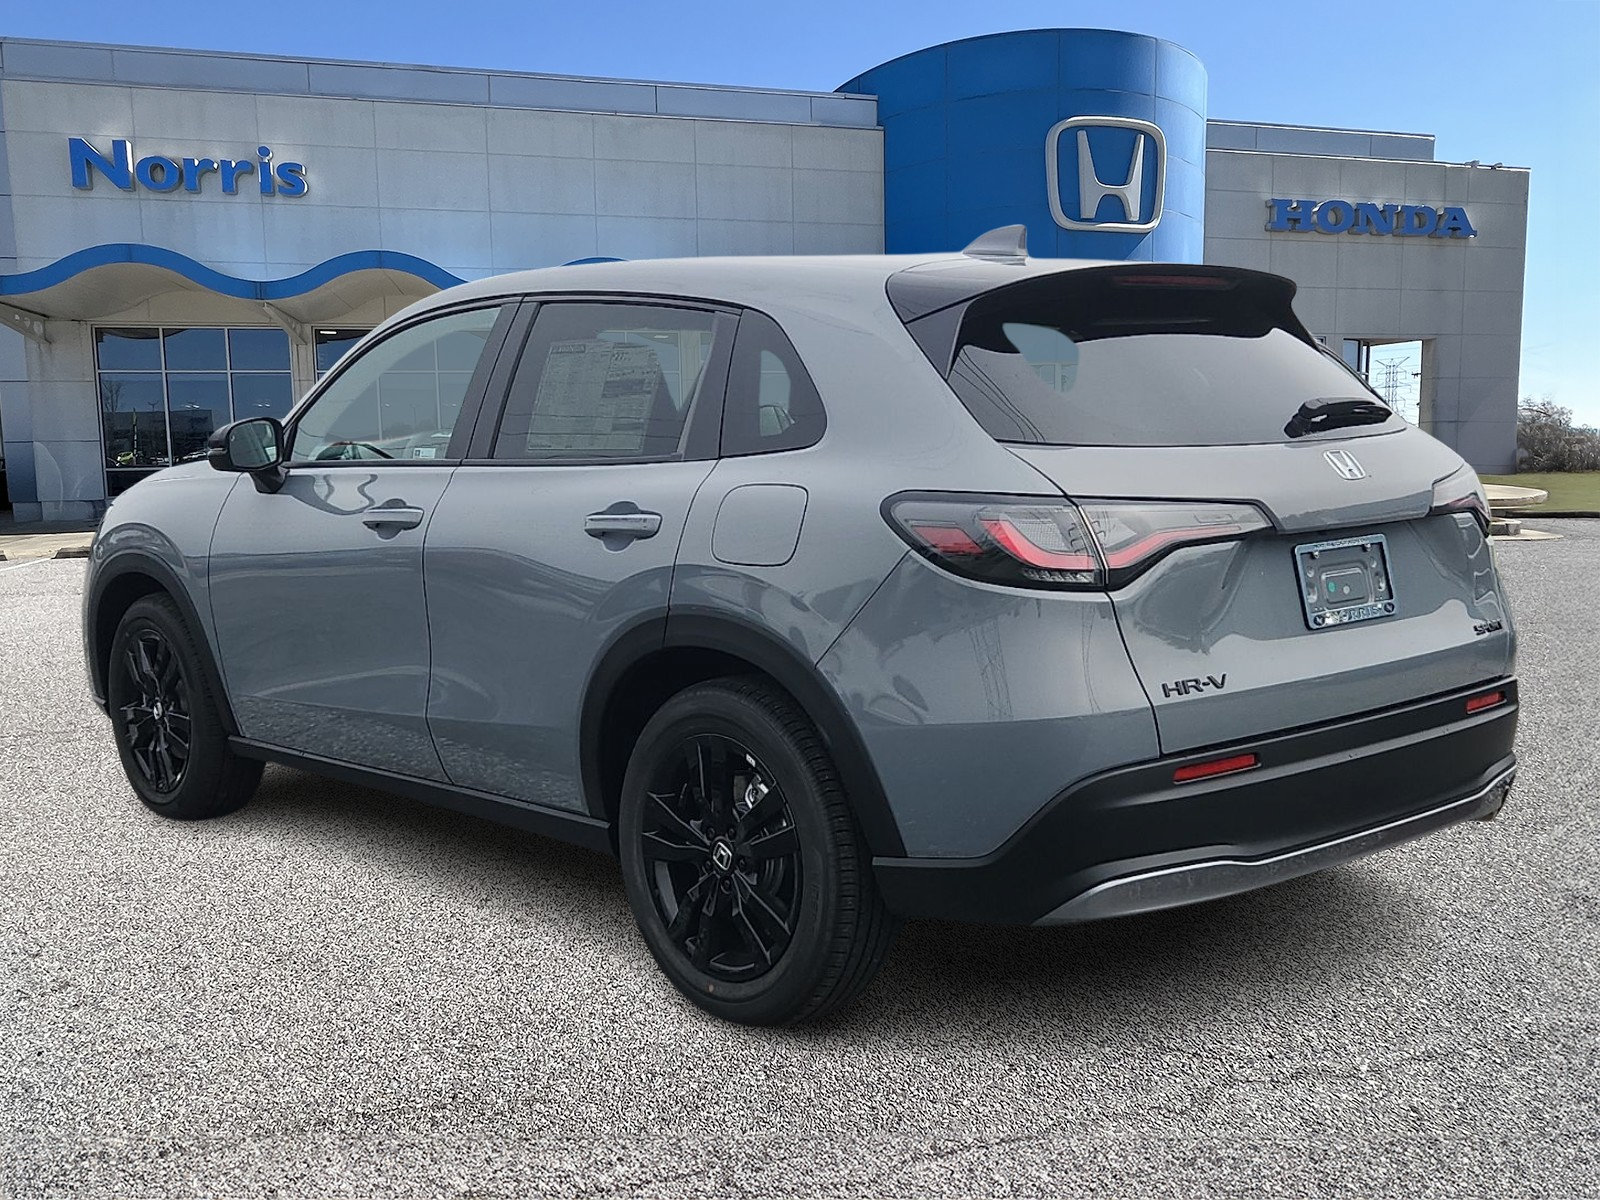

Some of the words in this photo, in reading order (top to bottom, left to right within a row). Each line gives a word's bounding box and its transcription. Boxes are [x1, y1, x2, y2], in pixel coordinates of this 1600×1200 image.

[68, 137, 308, 197] Norris
[1265, 198, 1477, 239] HONDA
[1161, 673, 1227, 698] HR-V
